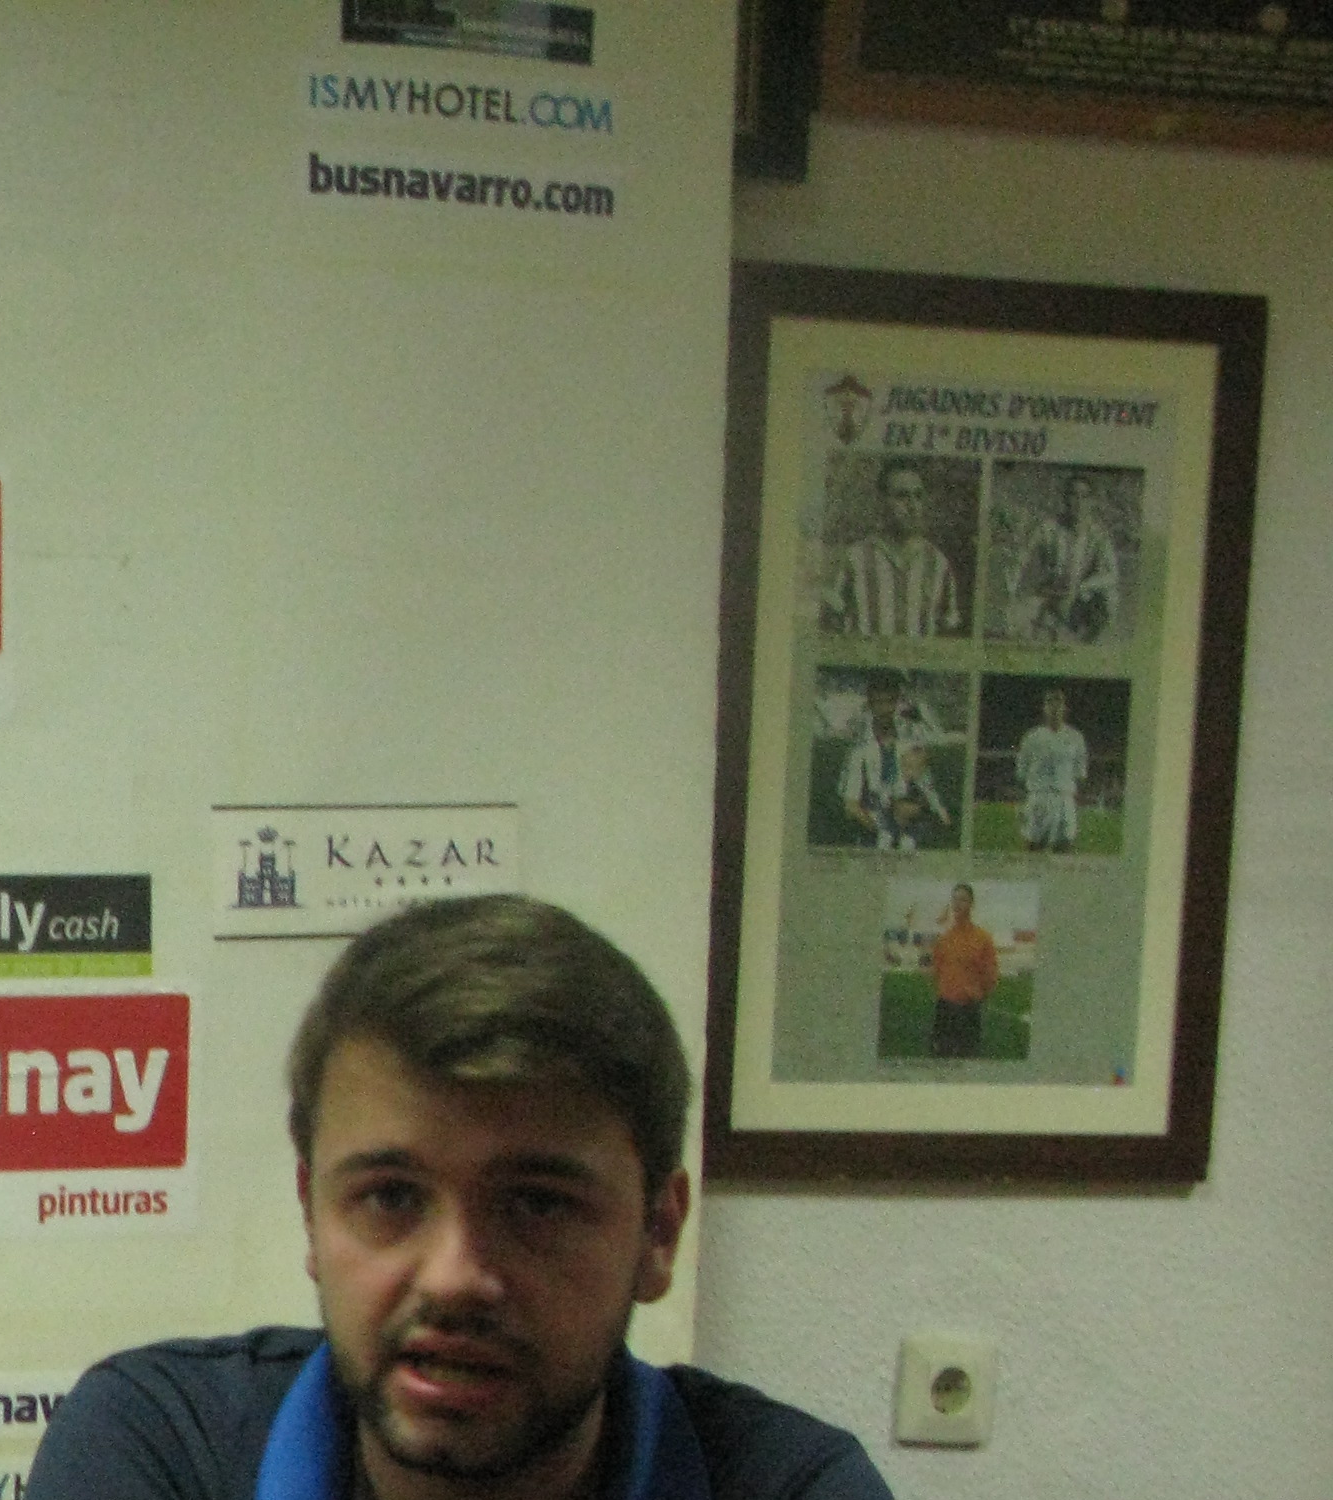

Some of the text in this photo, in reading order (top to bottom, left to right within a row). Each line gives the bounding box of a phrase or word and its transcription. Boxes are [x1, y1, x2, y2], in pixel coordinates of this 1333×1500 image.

[307, 73, 614, 136] ISMYHOTEL.COM
[308, 152, 615, 217] busnavarro.com
[327, 832, 502, 870] KAZAR
[49, 908, 120, 941] cash
[37, 1186, 169, 1224] pinturas
